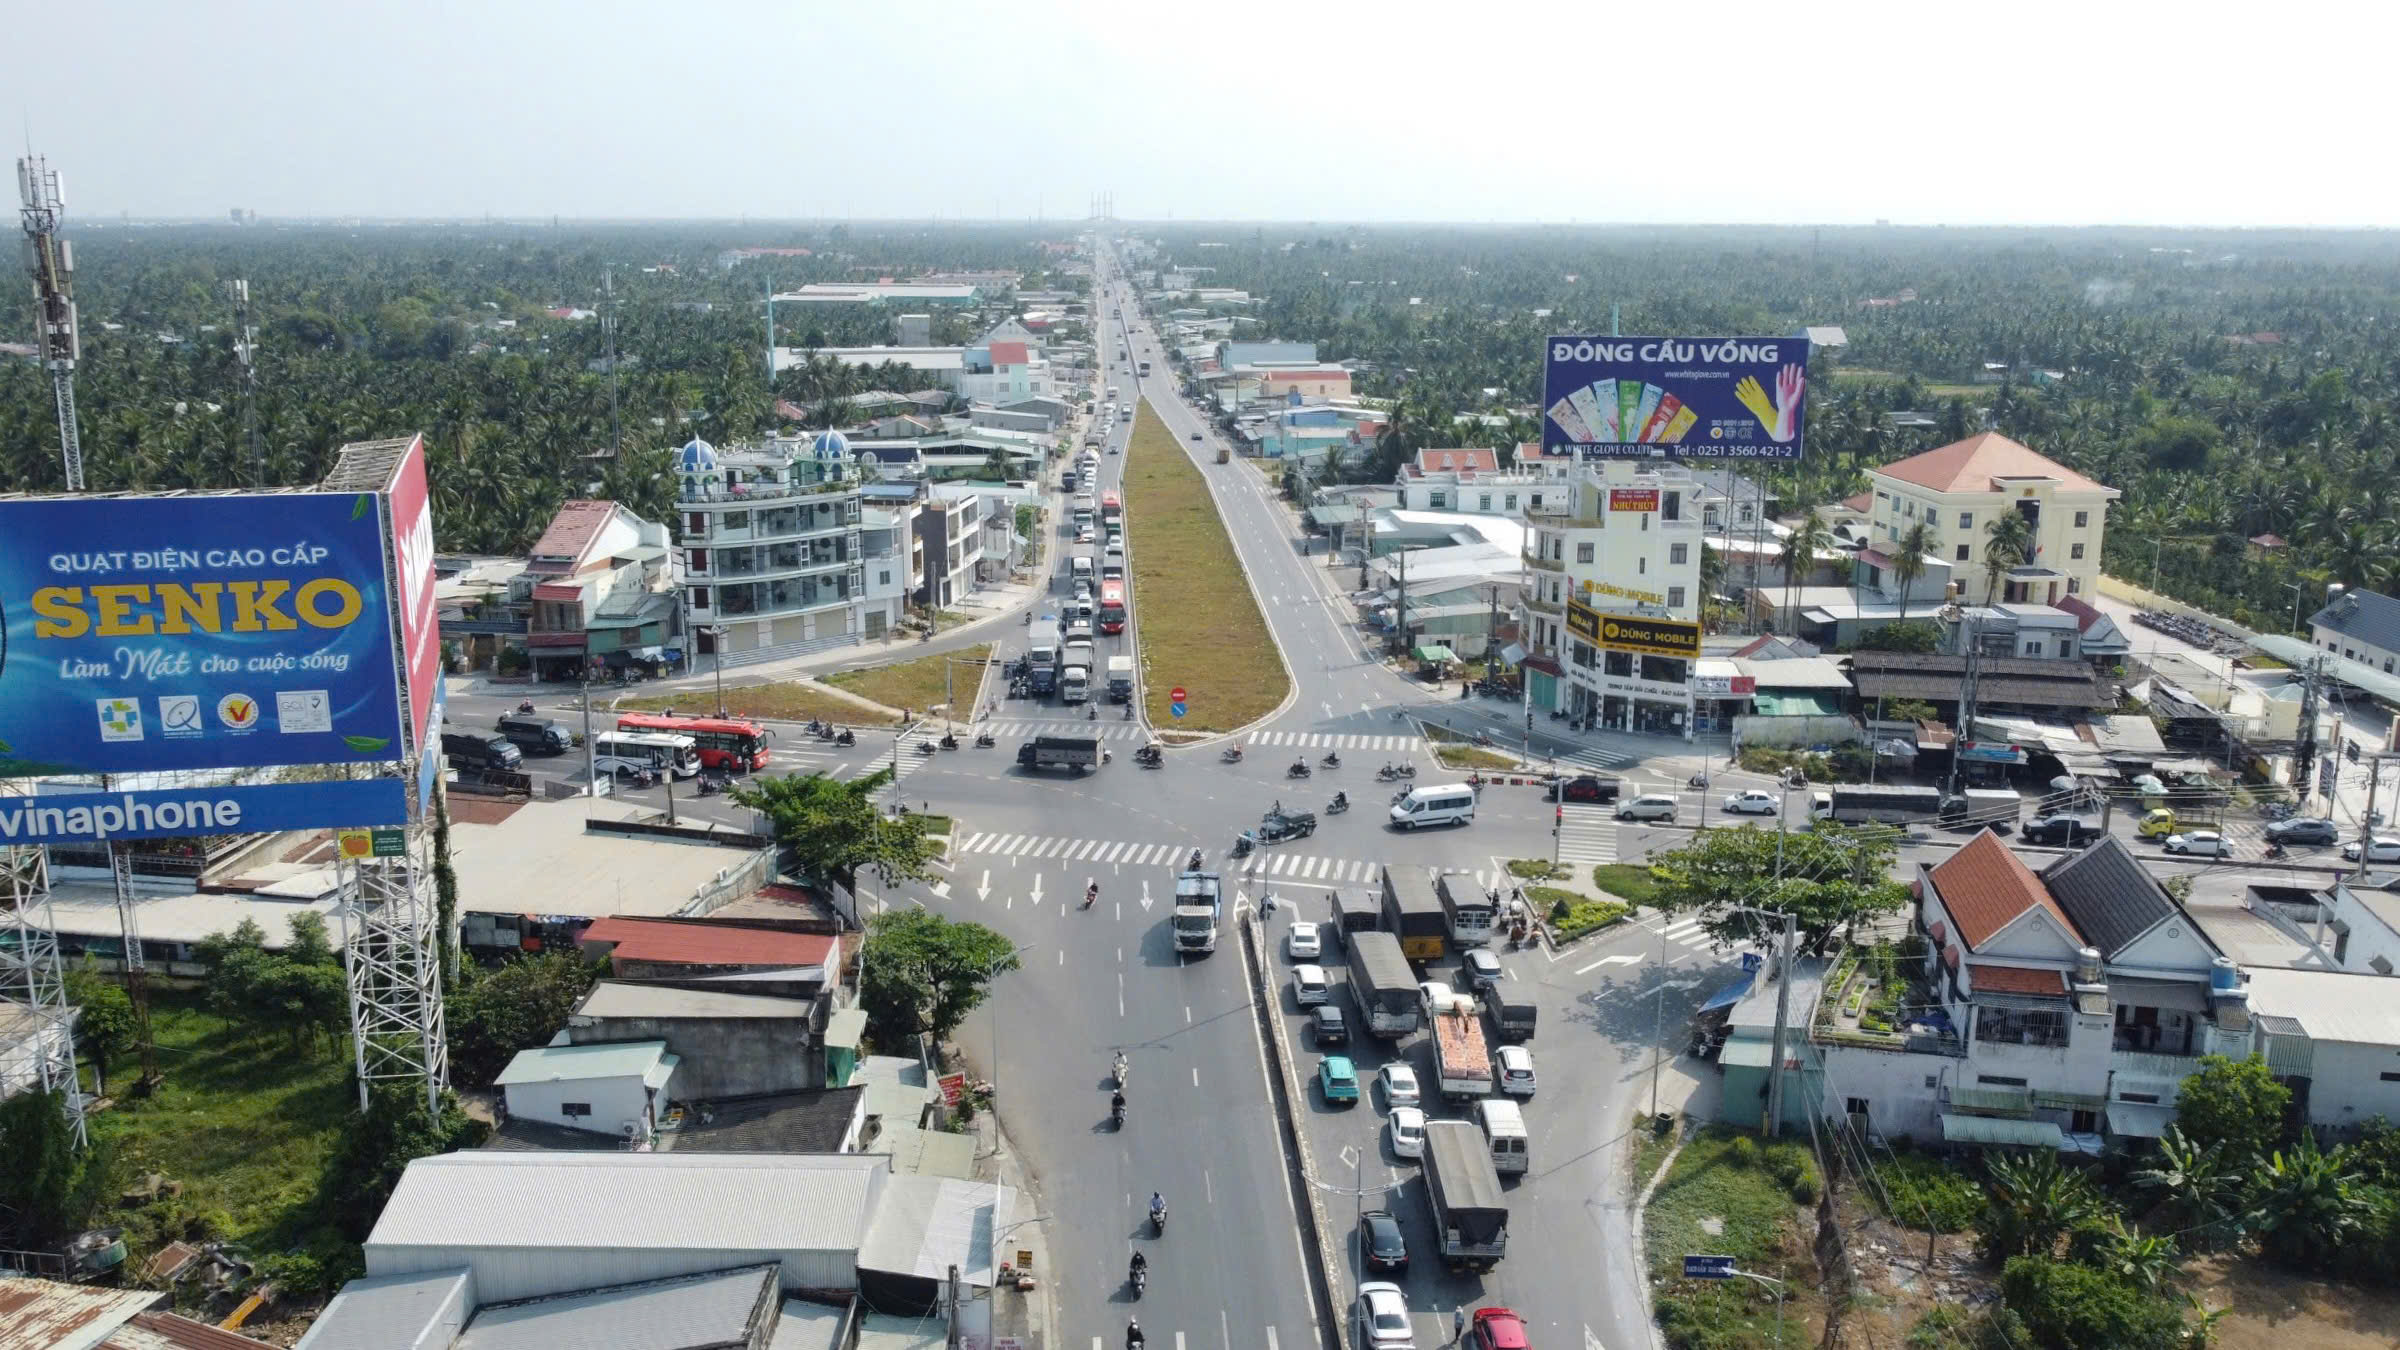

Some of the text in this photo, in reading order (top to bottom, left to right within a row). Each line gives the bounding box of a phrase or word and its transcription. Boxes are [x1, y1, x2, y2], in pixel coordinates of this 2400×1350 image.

[1553, 340, 1634, 362] ĐÔNG
[1594, 444, 1621, 455] GLOVE
[1673, 446, 1689, 456] Tel
[1698, 446, 1725, 456] 0251
[1729, 446, 1757, 456] 3560
[1760, 447, 1792, 457] 421-2
[50, 540, 328, 574] QUẠT ĐIỆN CAO CẤP
[31, 577, 363, 639] SENKO
[1655, 634, 1696, 645] MOBILE
[60, 647, 349, 681] Làm Mát cho cuộc sống
[0, 794, 241, 839] vinaphone
